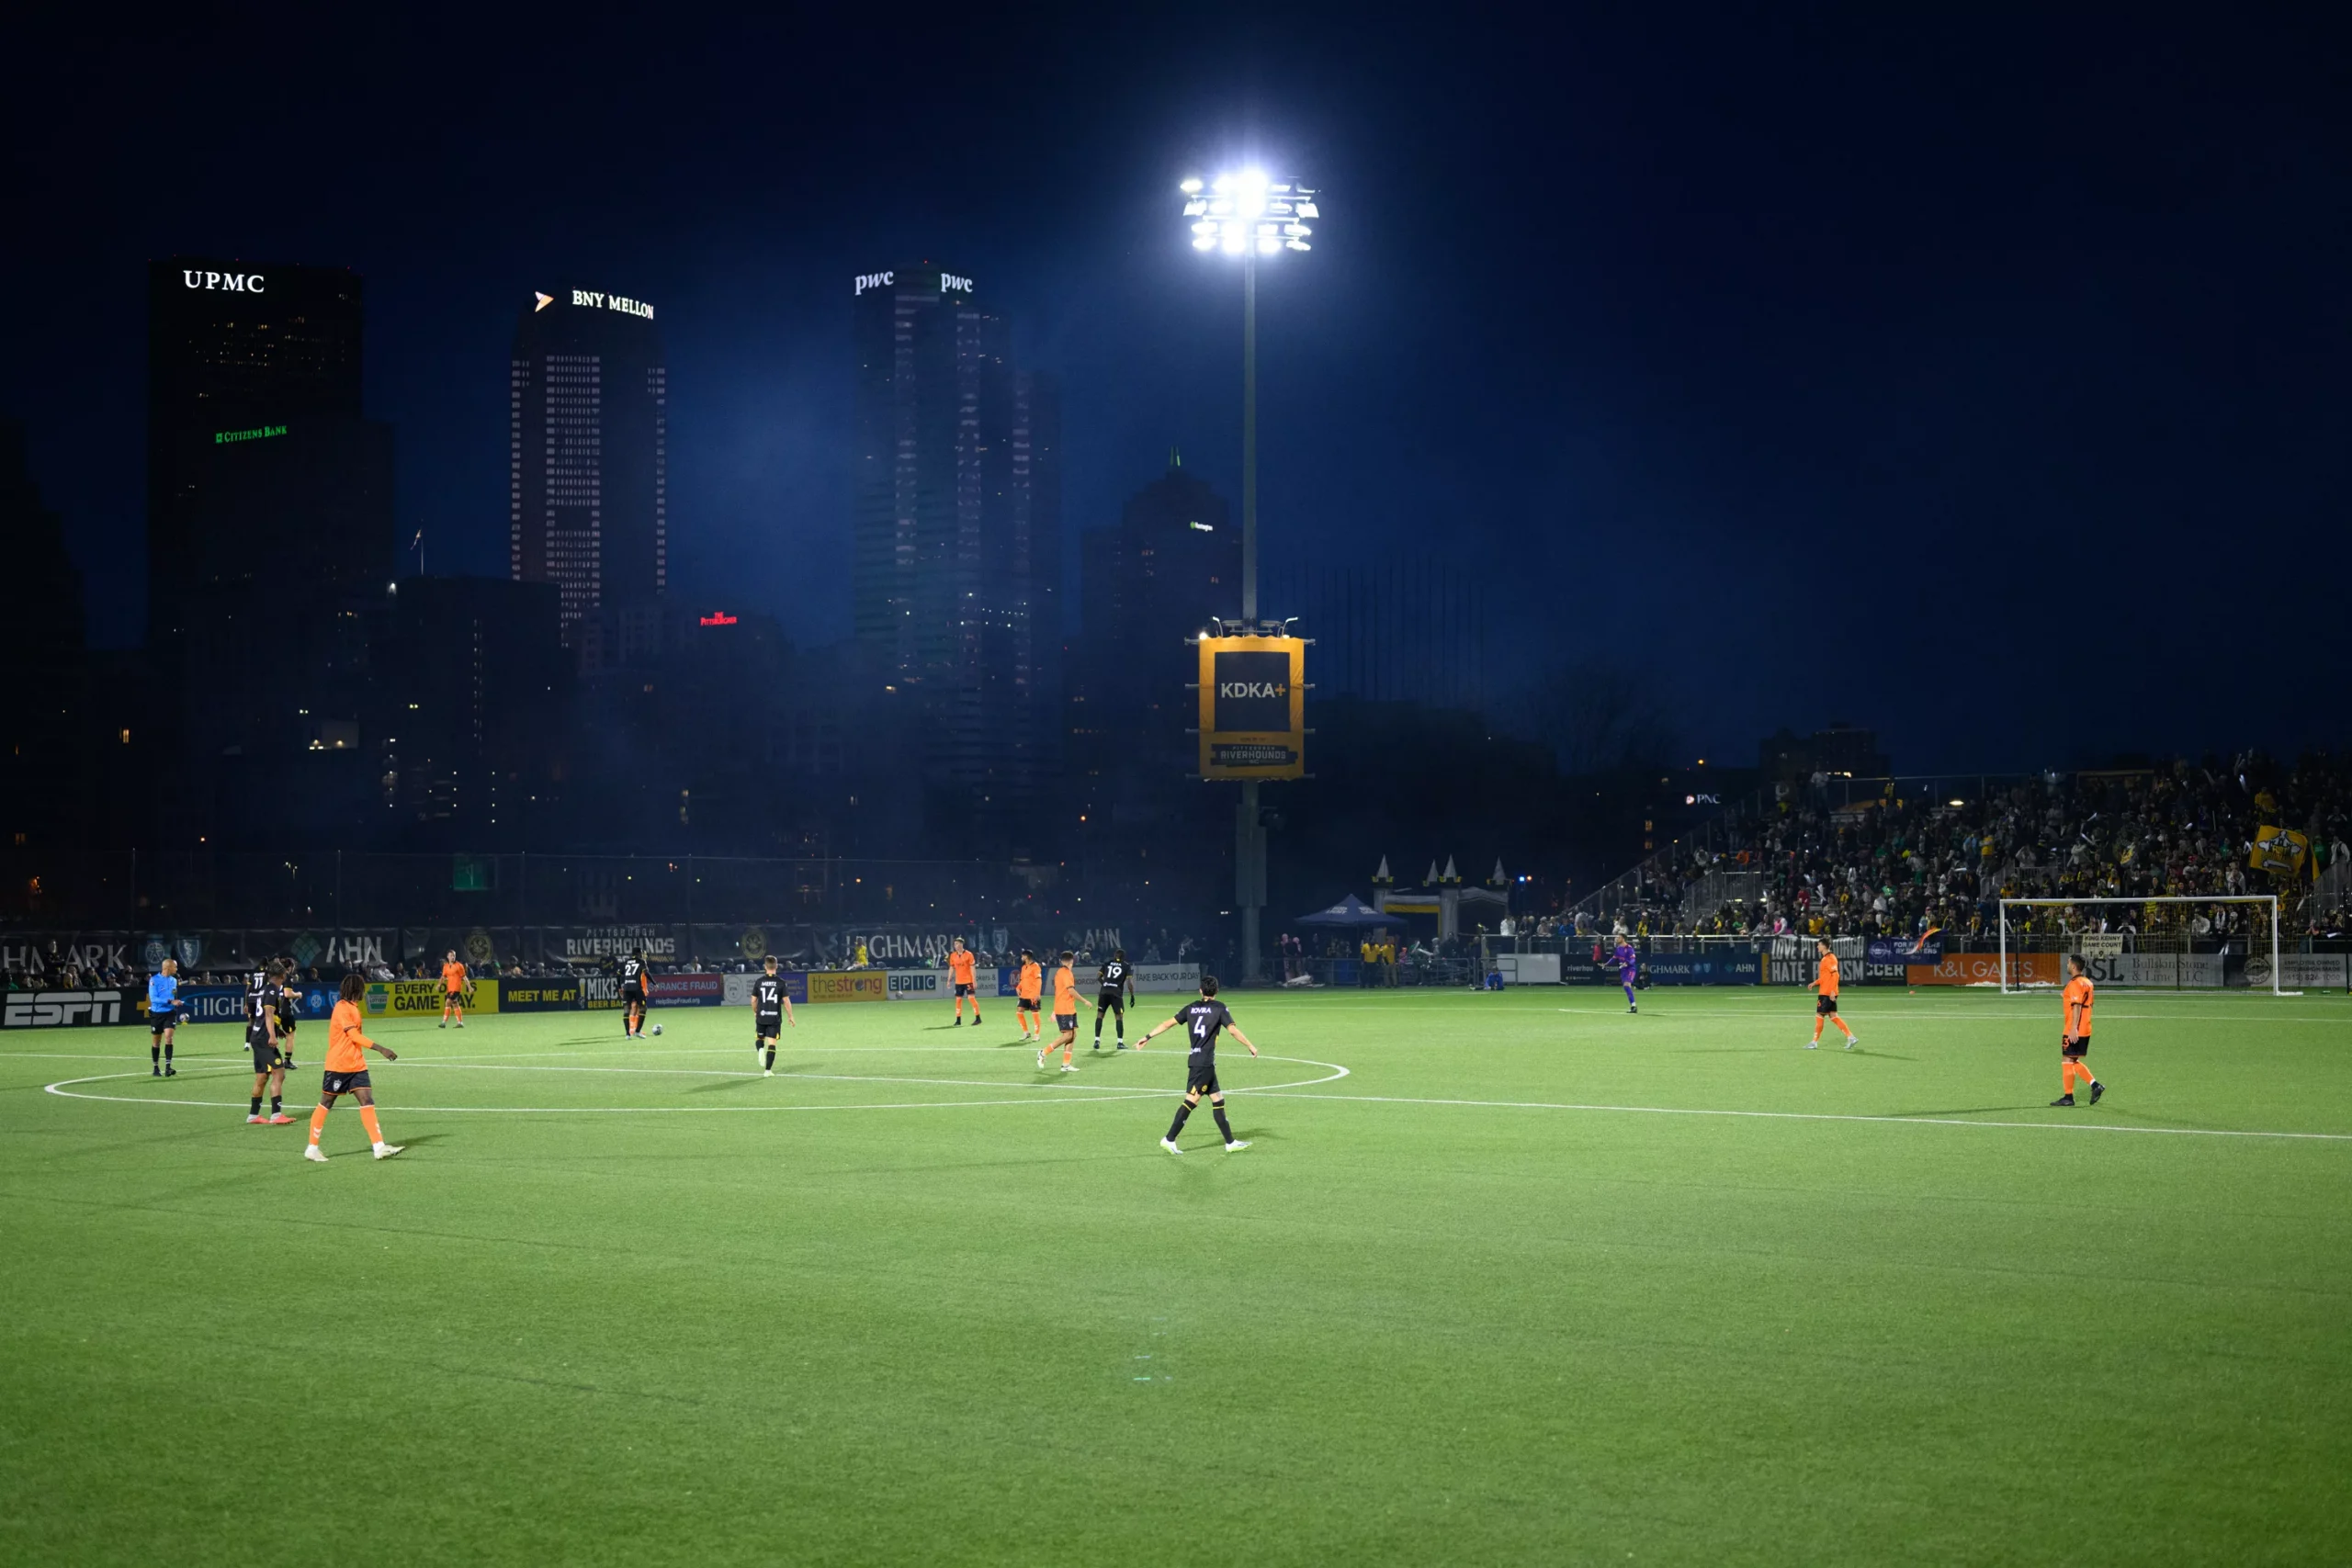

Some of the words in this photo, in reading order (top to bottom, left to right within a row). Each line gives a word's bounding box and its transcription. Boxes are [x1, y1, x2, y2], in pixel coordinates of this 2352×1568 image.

[183, 270, 265, 293] UPMC
[854, 271, 894, 296] pwc
[941, 273, 973, 293] pwc
[571, 290, 605, 308] BNY
[608, 295, 654, 320] MELLON
[224, 426, 263, 443] CITIZENS
[264, 425, 288, 436] BANK
[1220, 750, 1286, 760] RIVERHOUNDS
[1697, 794, 1721, 804] PNC
[566, 938, 676, 955] RIVERHOUNDS
[1084, 928, 1122, 951] AHN
[325, 936, 382, 964] AHN
[1771, 938, 1797, 960] LOVE
[625, 964, 639, 976] 27
[1735, 963, 1756, 973] AHN
[1933, 961, 1968, 977] K&L
[2132, 957, 2176, 969] Bullskin
[1107, 965, 1123, 979] 19
[1136, 974, 1151, 982] TAKE
[1153, 974, 1170, 982] BACK
[1771, 961, 1806, 982] HATE
[254, 976, 263, 989] 11
[394, 984, 435, 995] EVERY
[689, 981, 718, 990] FRAUD
[888, 976, 935, 991] EPIC
[508, 990, 539, 1002] MEET
[542, 990, 560, 1001] ME
[561, 989, 576, 1001] AT
[760, 987, 778, 1004] 14
[4, 990, 122, 1026] ESPN
[393, 996, 440, 1011] GAME
[588, 1000, 608, 1009] BEER
[1193, 1016, 1206, 1038] 4
